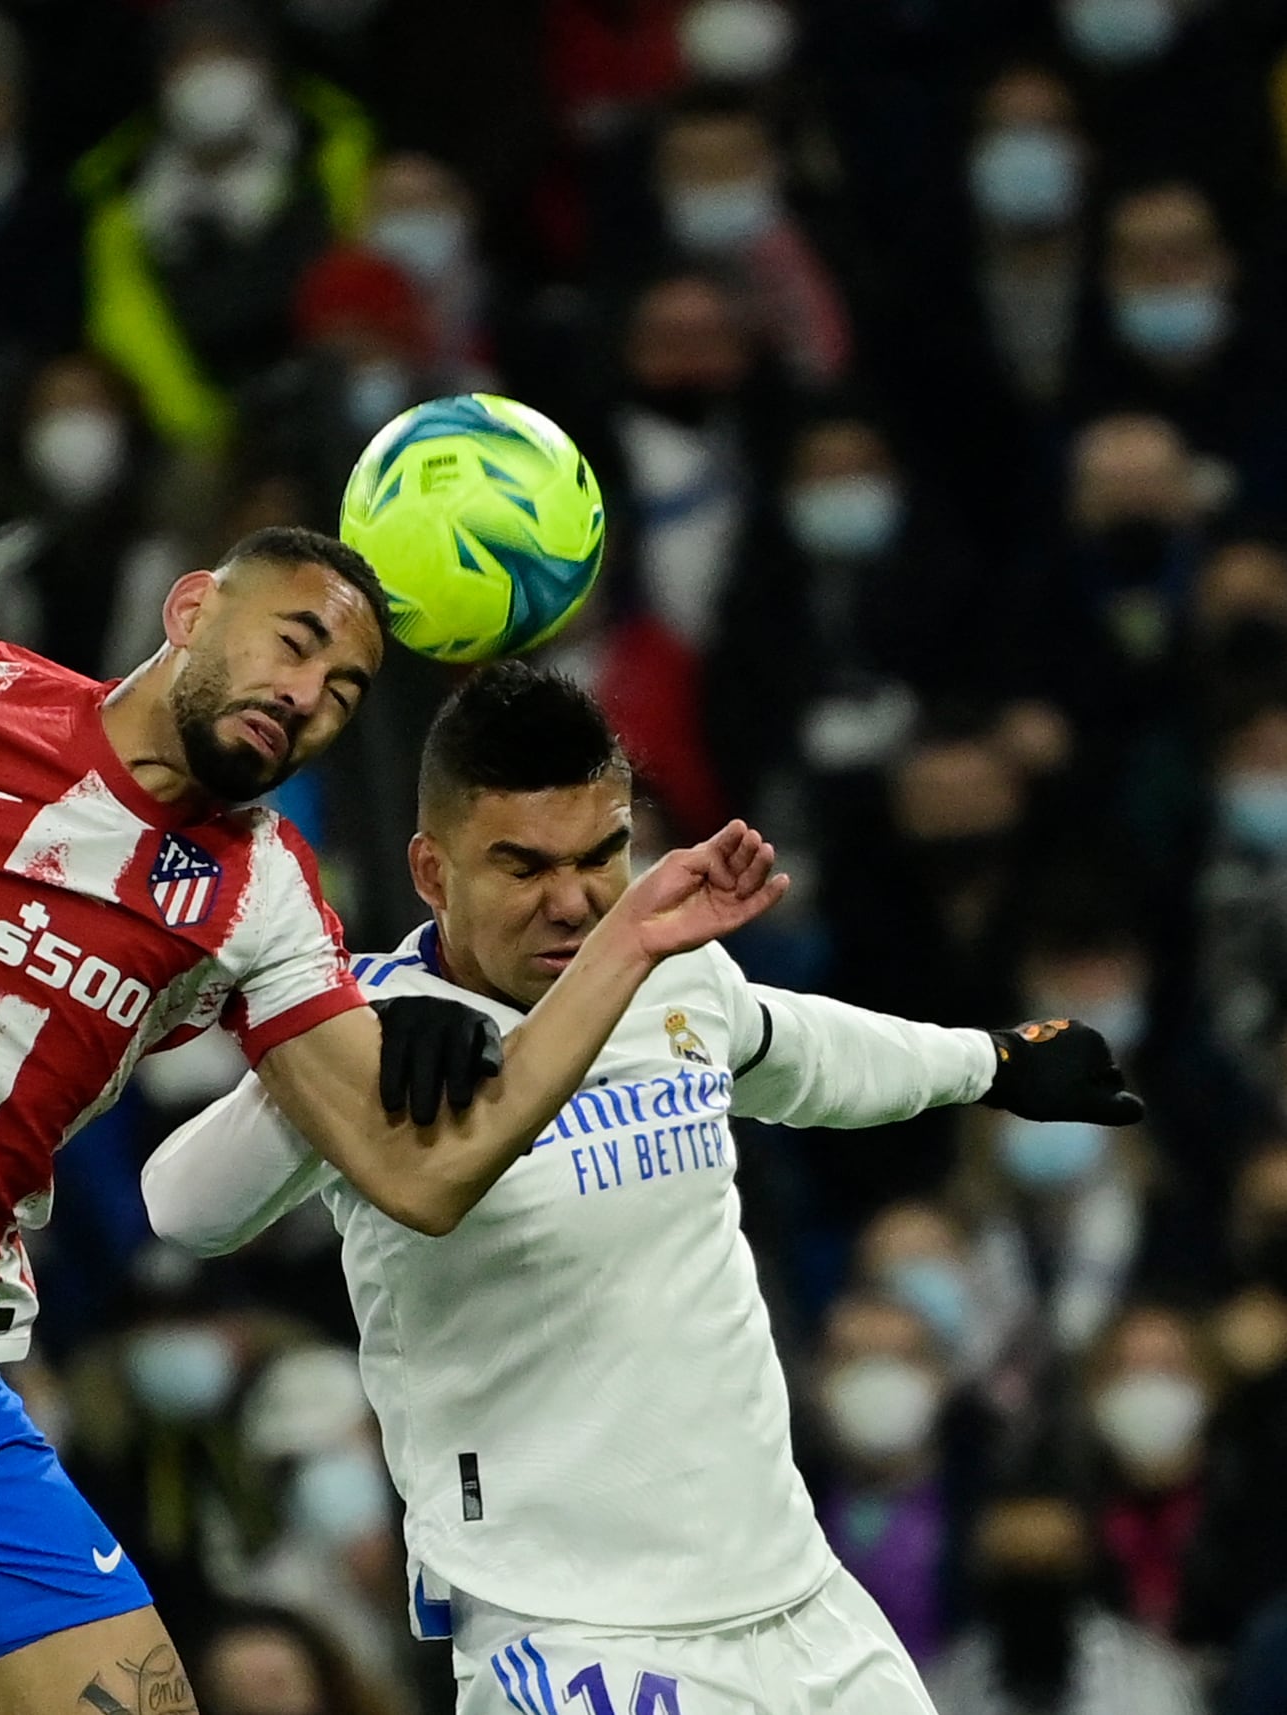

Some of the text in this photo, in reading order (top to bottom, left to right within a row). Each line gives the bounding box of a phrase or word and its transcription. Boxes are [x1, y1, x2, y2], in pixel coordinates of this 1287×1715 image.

[532, 1066, 731, 1148] mirate
[571, 1122, 728, 1195] FLY BETTER
